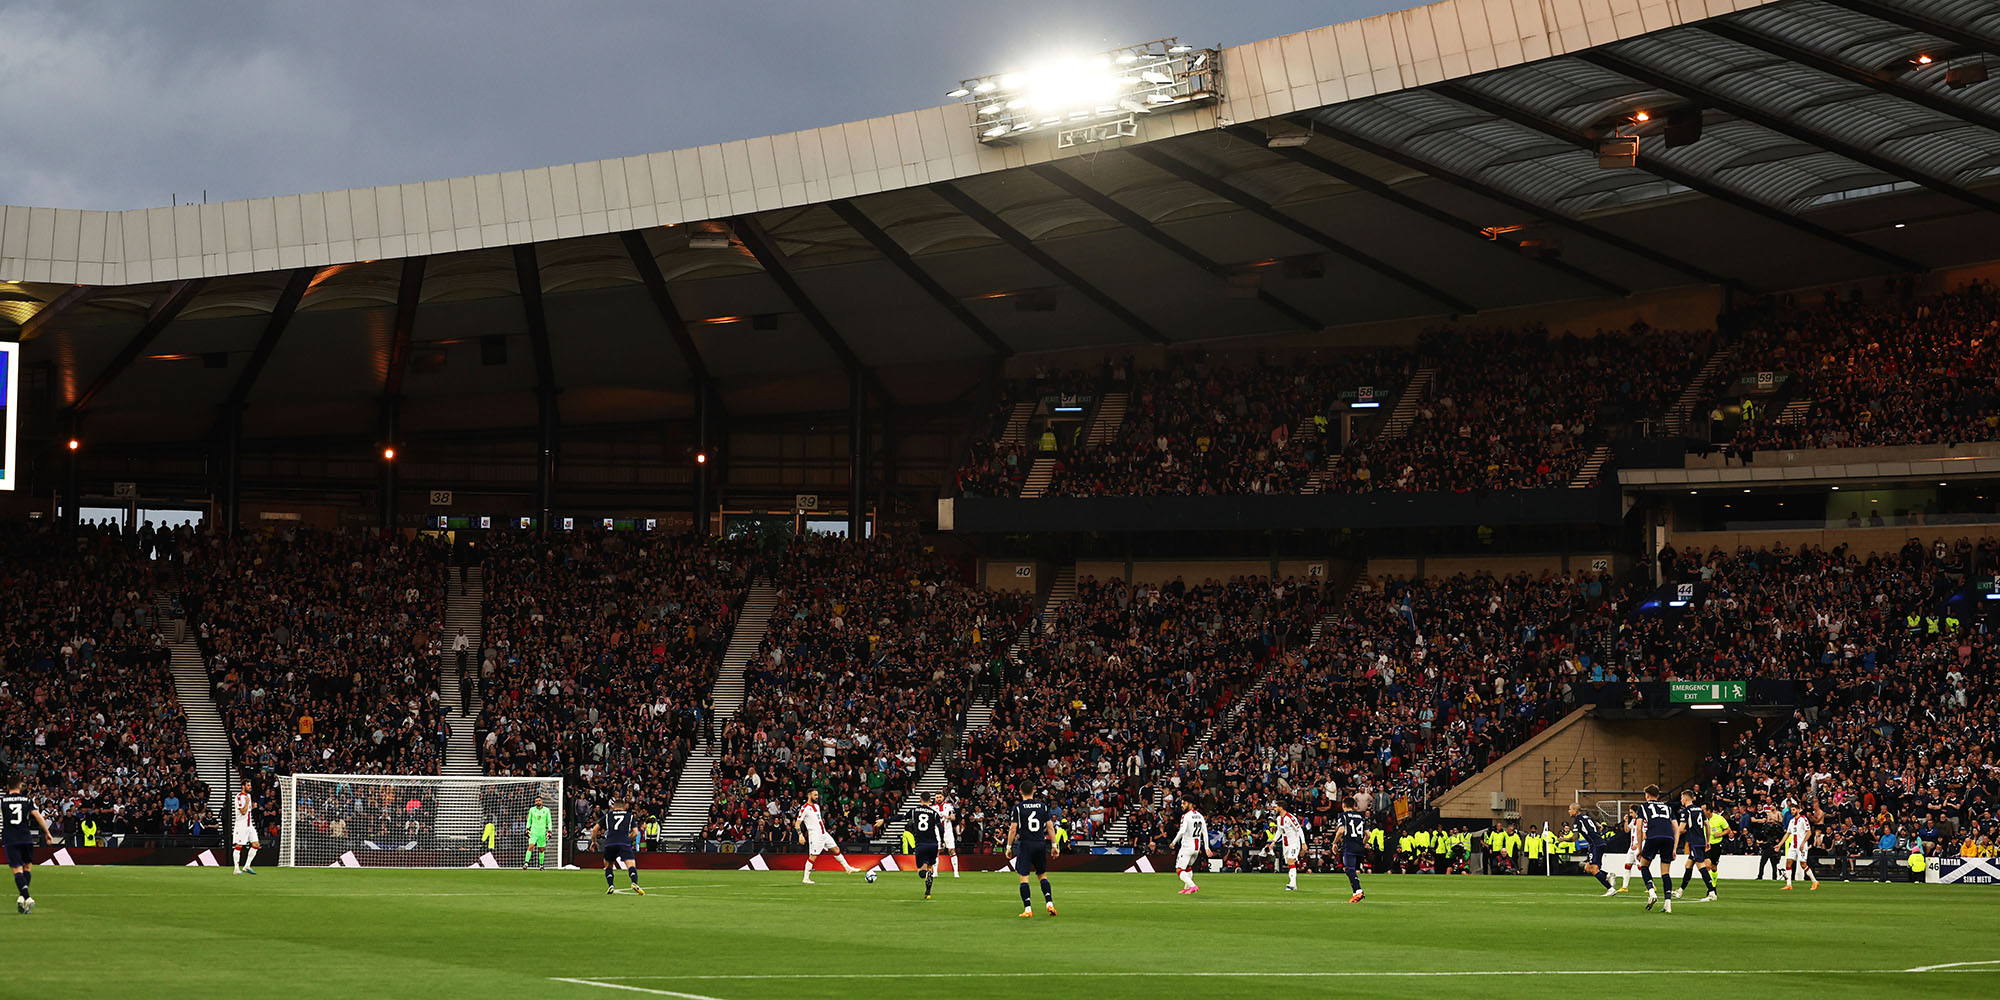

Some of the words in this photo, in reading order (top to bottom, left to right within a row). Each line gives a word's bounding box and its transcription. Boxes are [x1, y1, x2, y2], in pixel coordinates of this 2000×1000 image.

[1759, 373, 1772, 383] 59
[1342, 390, 1357, 398] EXIT
[1360, 388, 1373, 397] 58
[1375, 390, 1389, 398] EXIT
[432, 492, 450, 504] 38
[800, 496, 817, 507] 39
[1017, 566, 1031, 576] 40
[1310, 565, 1322, 575] 41
[1593, 561, 1607, 572] 42
[1679, 585, 1693, 594] 44
[1977, 582, 1993, 590] EXIT
[9, 803, 22, 825] 3
[1648, 804, 1670, 819] 13
[614, 815, 625, 831] 7
[918, 813, 929, 831] 8
[1028, 811, 1040, 832] 6
[1697, 812, 1704, 829] 4
[1193, 821, 1202, 838] 22
[1349, 819, 1364, 838] 14
[1929, 862, 1940, 871] 46
[1940, 858, 1961, 866] TARTAN
